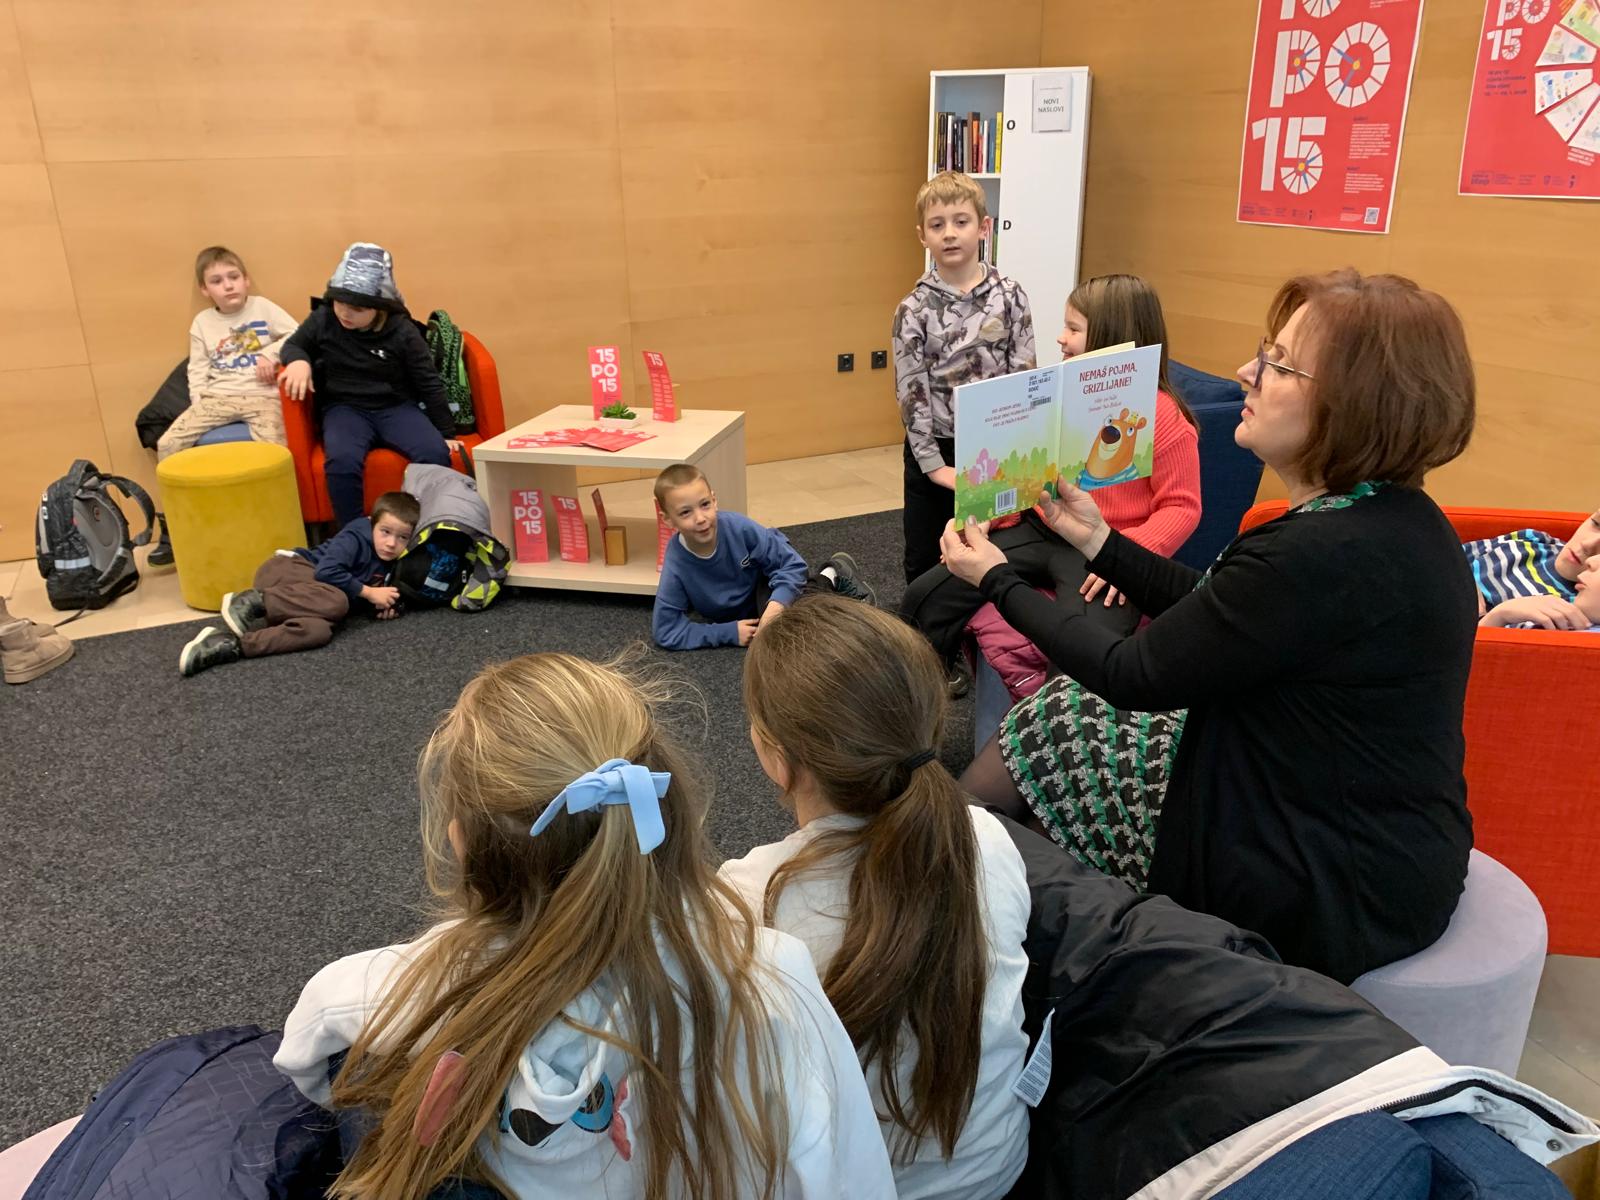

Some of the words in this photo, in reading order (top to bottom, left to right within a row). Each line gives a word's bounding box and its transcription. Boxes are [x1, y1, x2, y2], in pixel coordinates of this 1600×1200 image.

[1496, 0, 1550, 26] PO
[1487, 28, 1523, 61] 15
[1269, 21, 1391, 108] PO
[1006, 120, 1016, 131] O
[1252, 116, 1327, 195] 15
[1003, 220, 1012, 230] D
[596, 348, 615, 363] 15
[648, 352, 664, 367] 15
[591, 363, 618, 378] PO
[1079, 365, 1107, 383] NEMAŠ
[598, 378, 618, 393] 15
[1082, 376, 1132, 395] GRIZLIJANE!
[519, 491, 539, 506] 15
[558, 497, 577, 511] 15
[514, 506, 542, 520] PO
[522, 520, 542, 535] 15
